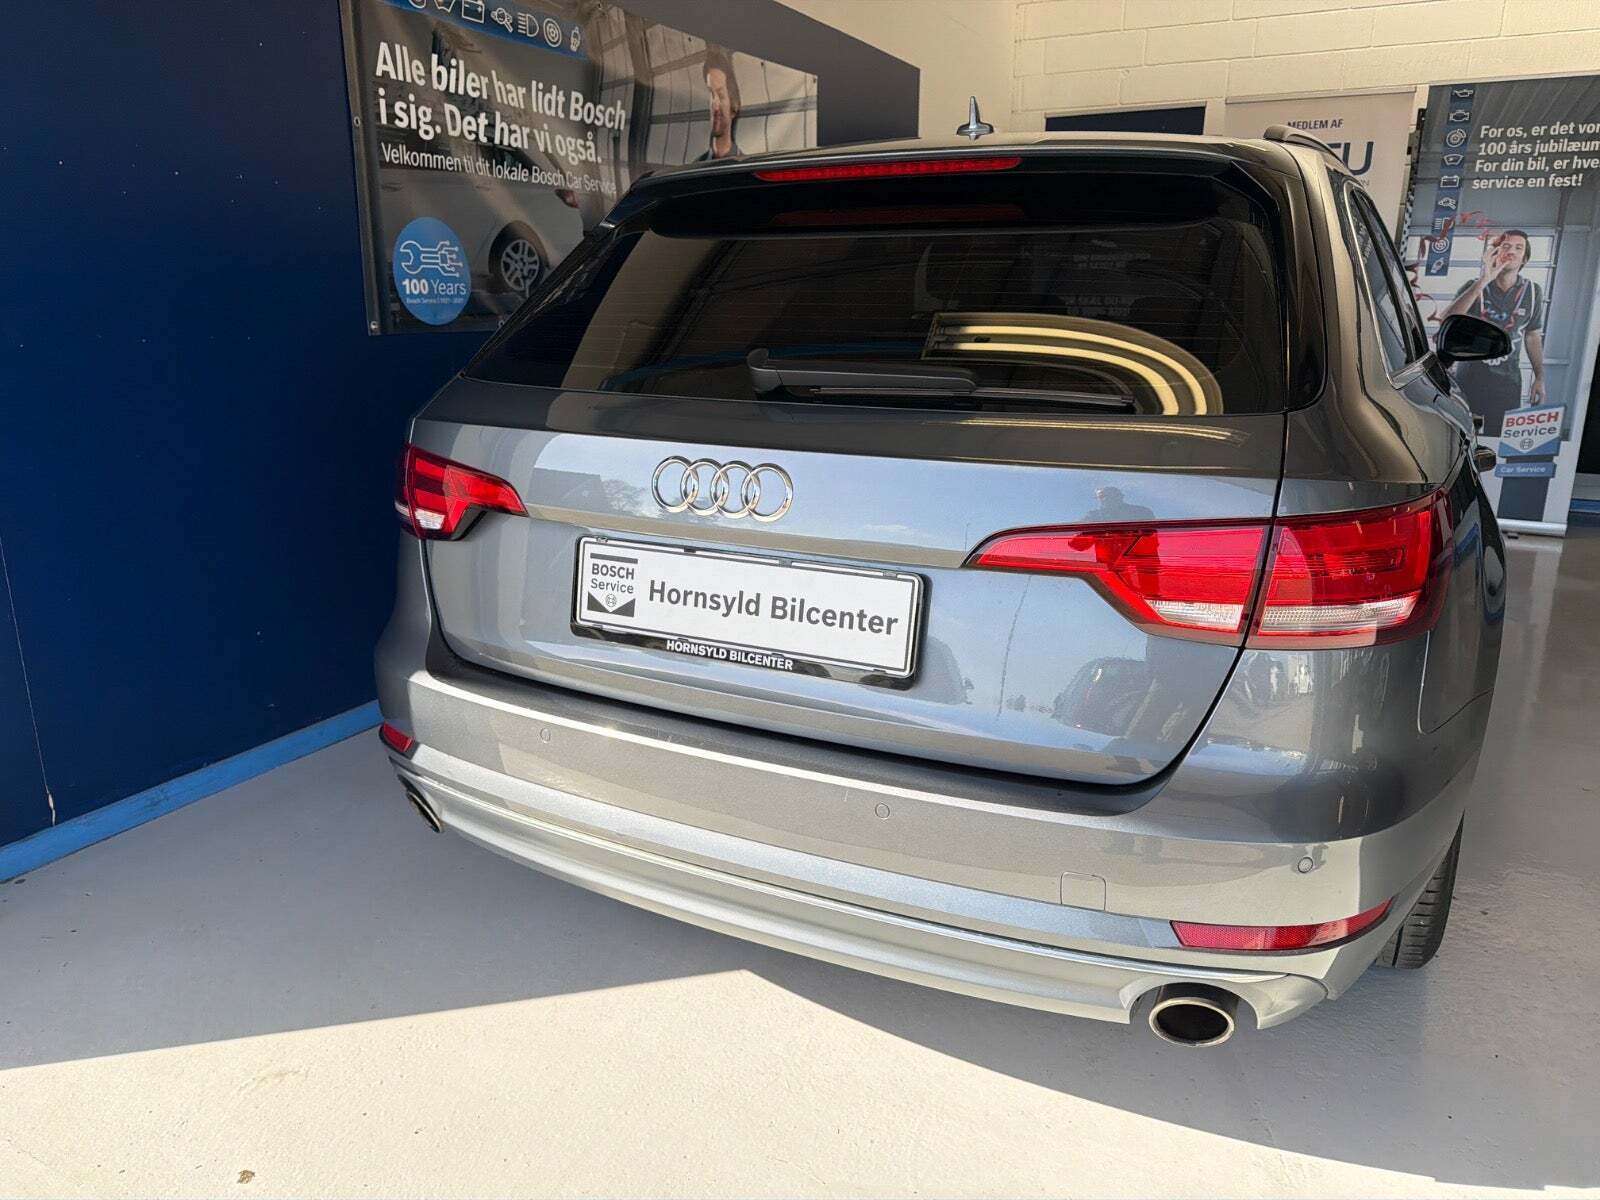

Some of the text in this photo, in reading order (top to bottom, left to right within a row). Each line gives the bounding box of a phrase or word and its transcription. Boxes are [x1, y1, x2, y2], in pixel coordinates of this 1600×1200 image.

[376, 41, 626, 131] Alle biler har lidt Bosch
[378, 87, 602, 165] i sig. Det har vi også.
[1330, 119, 1344, 129] AF
[1480, 125, 1504, 139] For
[1506, 126, 1528, 139] os,
[1531, 125, 1548, 137] er
[1550, 121, 1577, 135] det
[1478, 142, 1507, 156] 100
[1508, 140, 1533, 155] års
[381, 142, 617, 196] Velkommen til dit lokale Bosch Car Service
[1475, 159, 1499, 173] For
[1501, 158, 1524, 172] din
[1526, 156, 1550, 172] bil,
[1553, 159, 1570, 170] er
[1471, 173, 1584, 190] service en fest!
[402, 279, 467, 296] 100 Years
[1503, 411, 1559, 439] BOSCH Service
[591, 563, 635, 581] BOSCH
[590, 578, 634, 594] Service
[649, 579, 899, 635] Hornsyld Bilcenter
[666, 640, 794, 671] HORNSYLD BILCENTER
